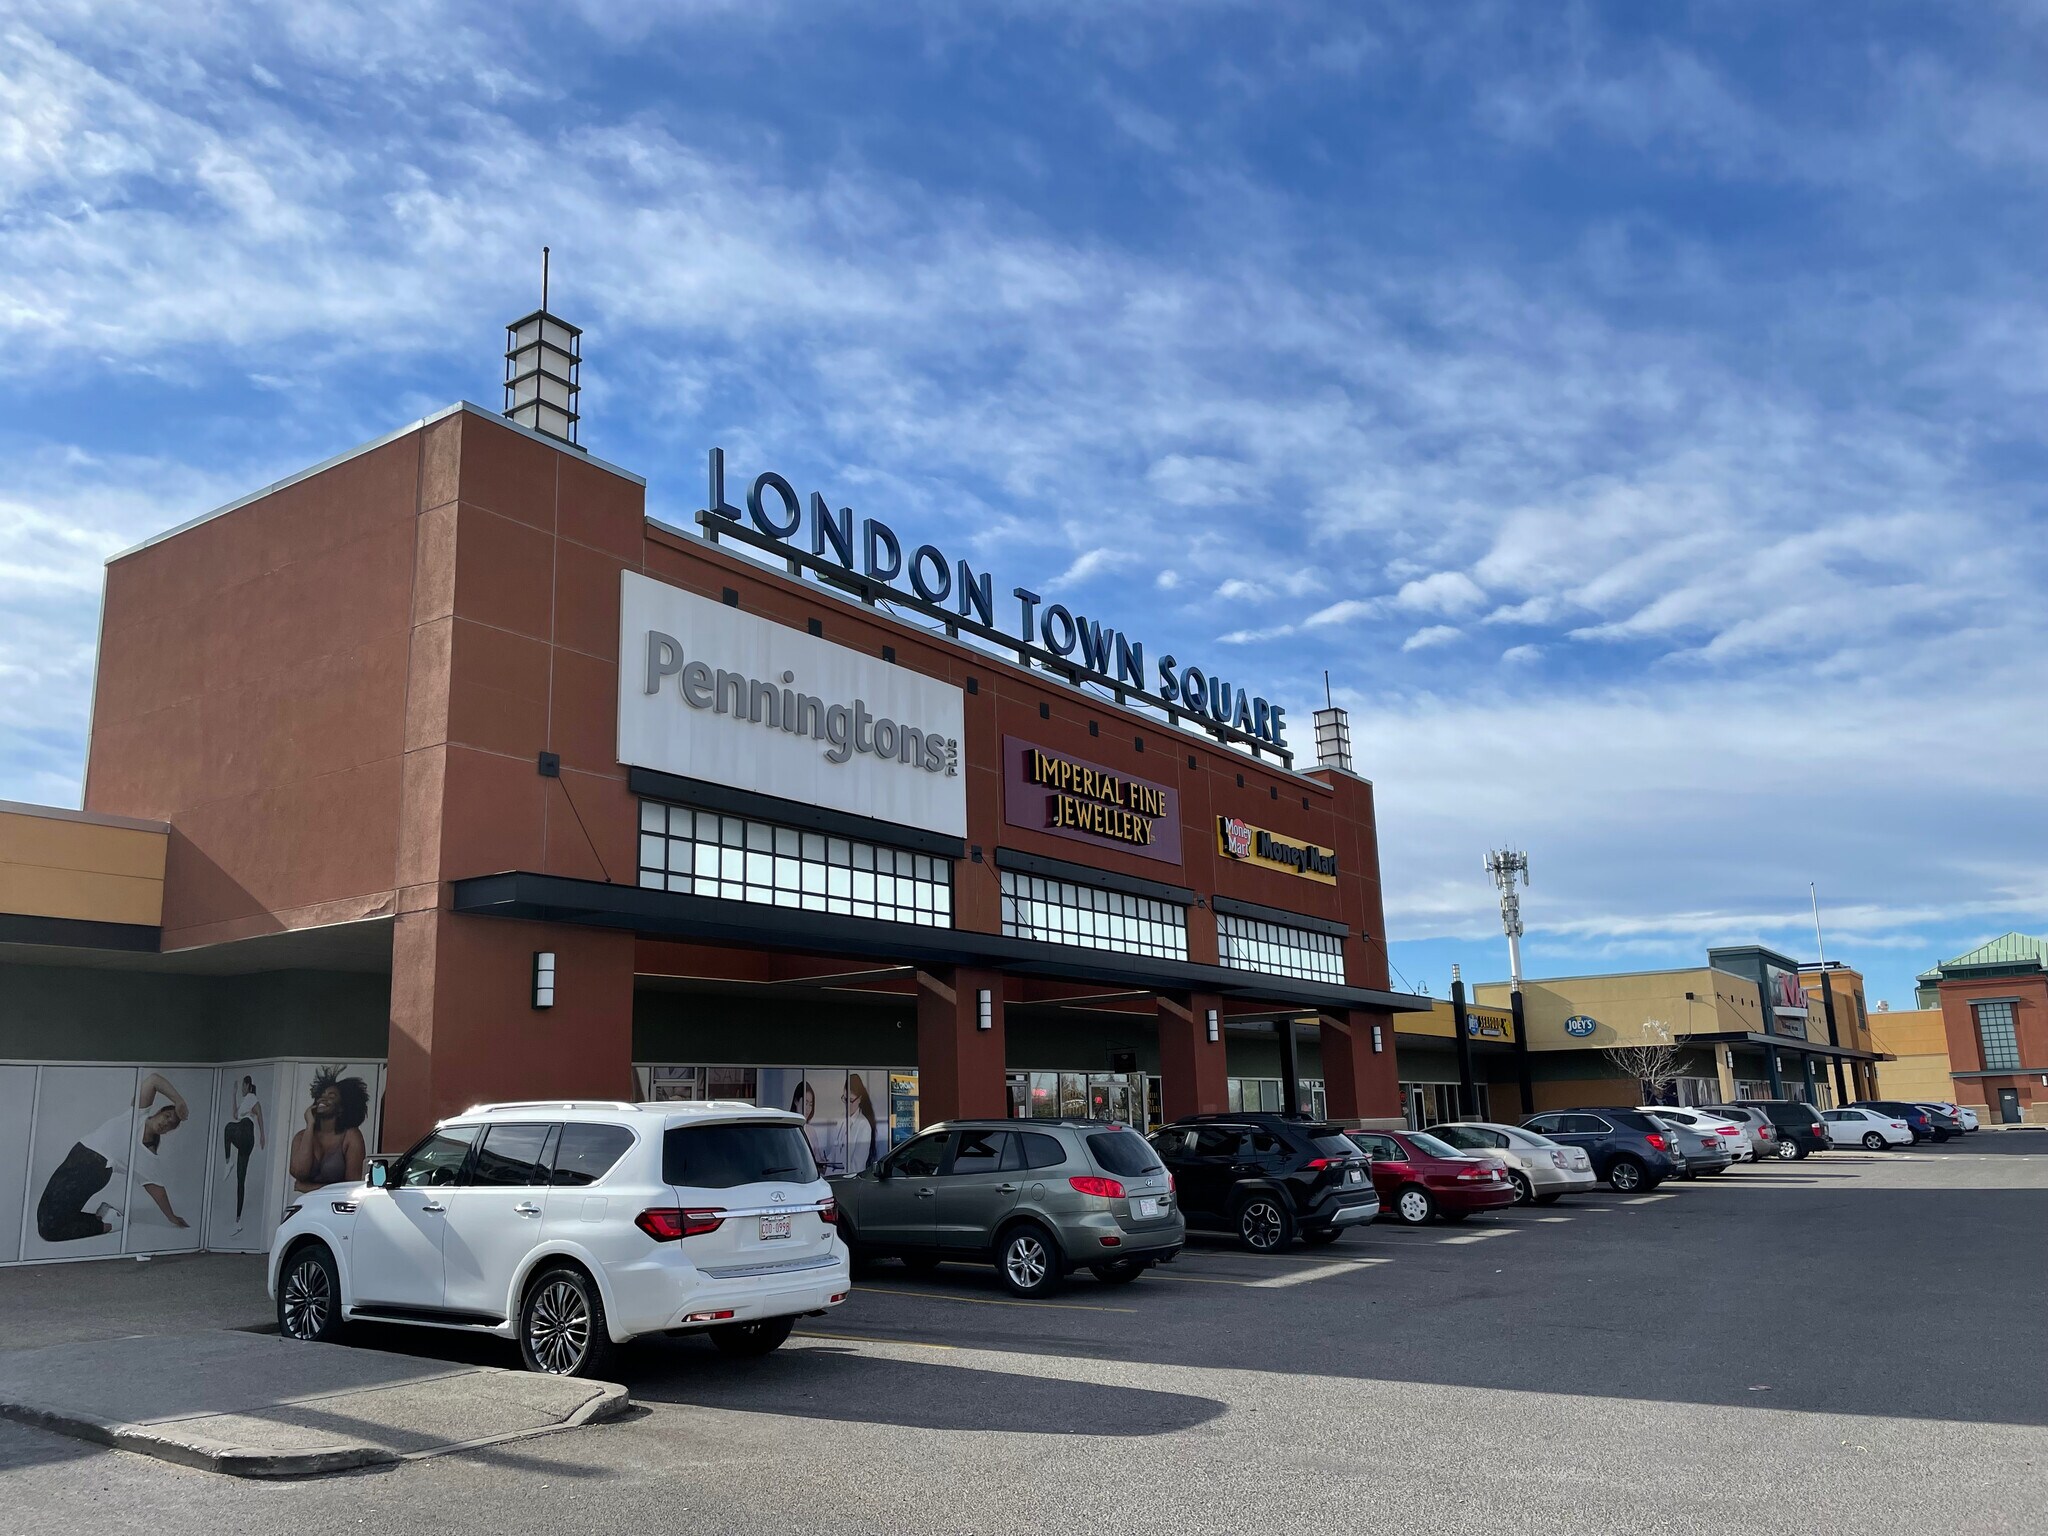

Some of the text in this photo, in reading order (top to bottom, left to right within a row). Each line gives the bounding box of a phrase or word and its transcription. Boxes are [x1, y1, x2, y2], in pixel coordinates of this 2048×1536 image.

[708, 447, 1288, 748] LONDON TOWN SQUARE
[644, 630, 946, 773] Penningtons
[946, 738, 958, 777] PLUS
[1032, 748, 1167, 818] IMPERIAL FINE
[1055, 794, 1153, 845] JEWELLERY
[1224, 816, 1253, 844] Money
[1228, 835, 1250, 857] Mart
[1258, 831, 1308, 873] Money
[1567, 1019, 1592, 1032] JOEY'S
